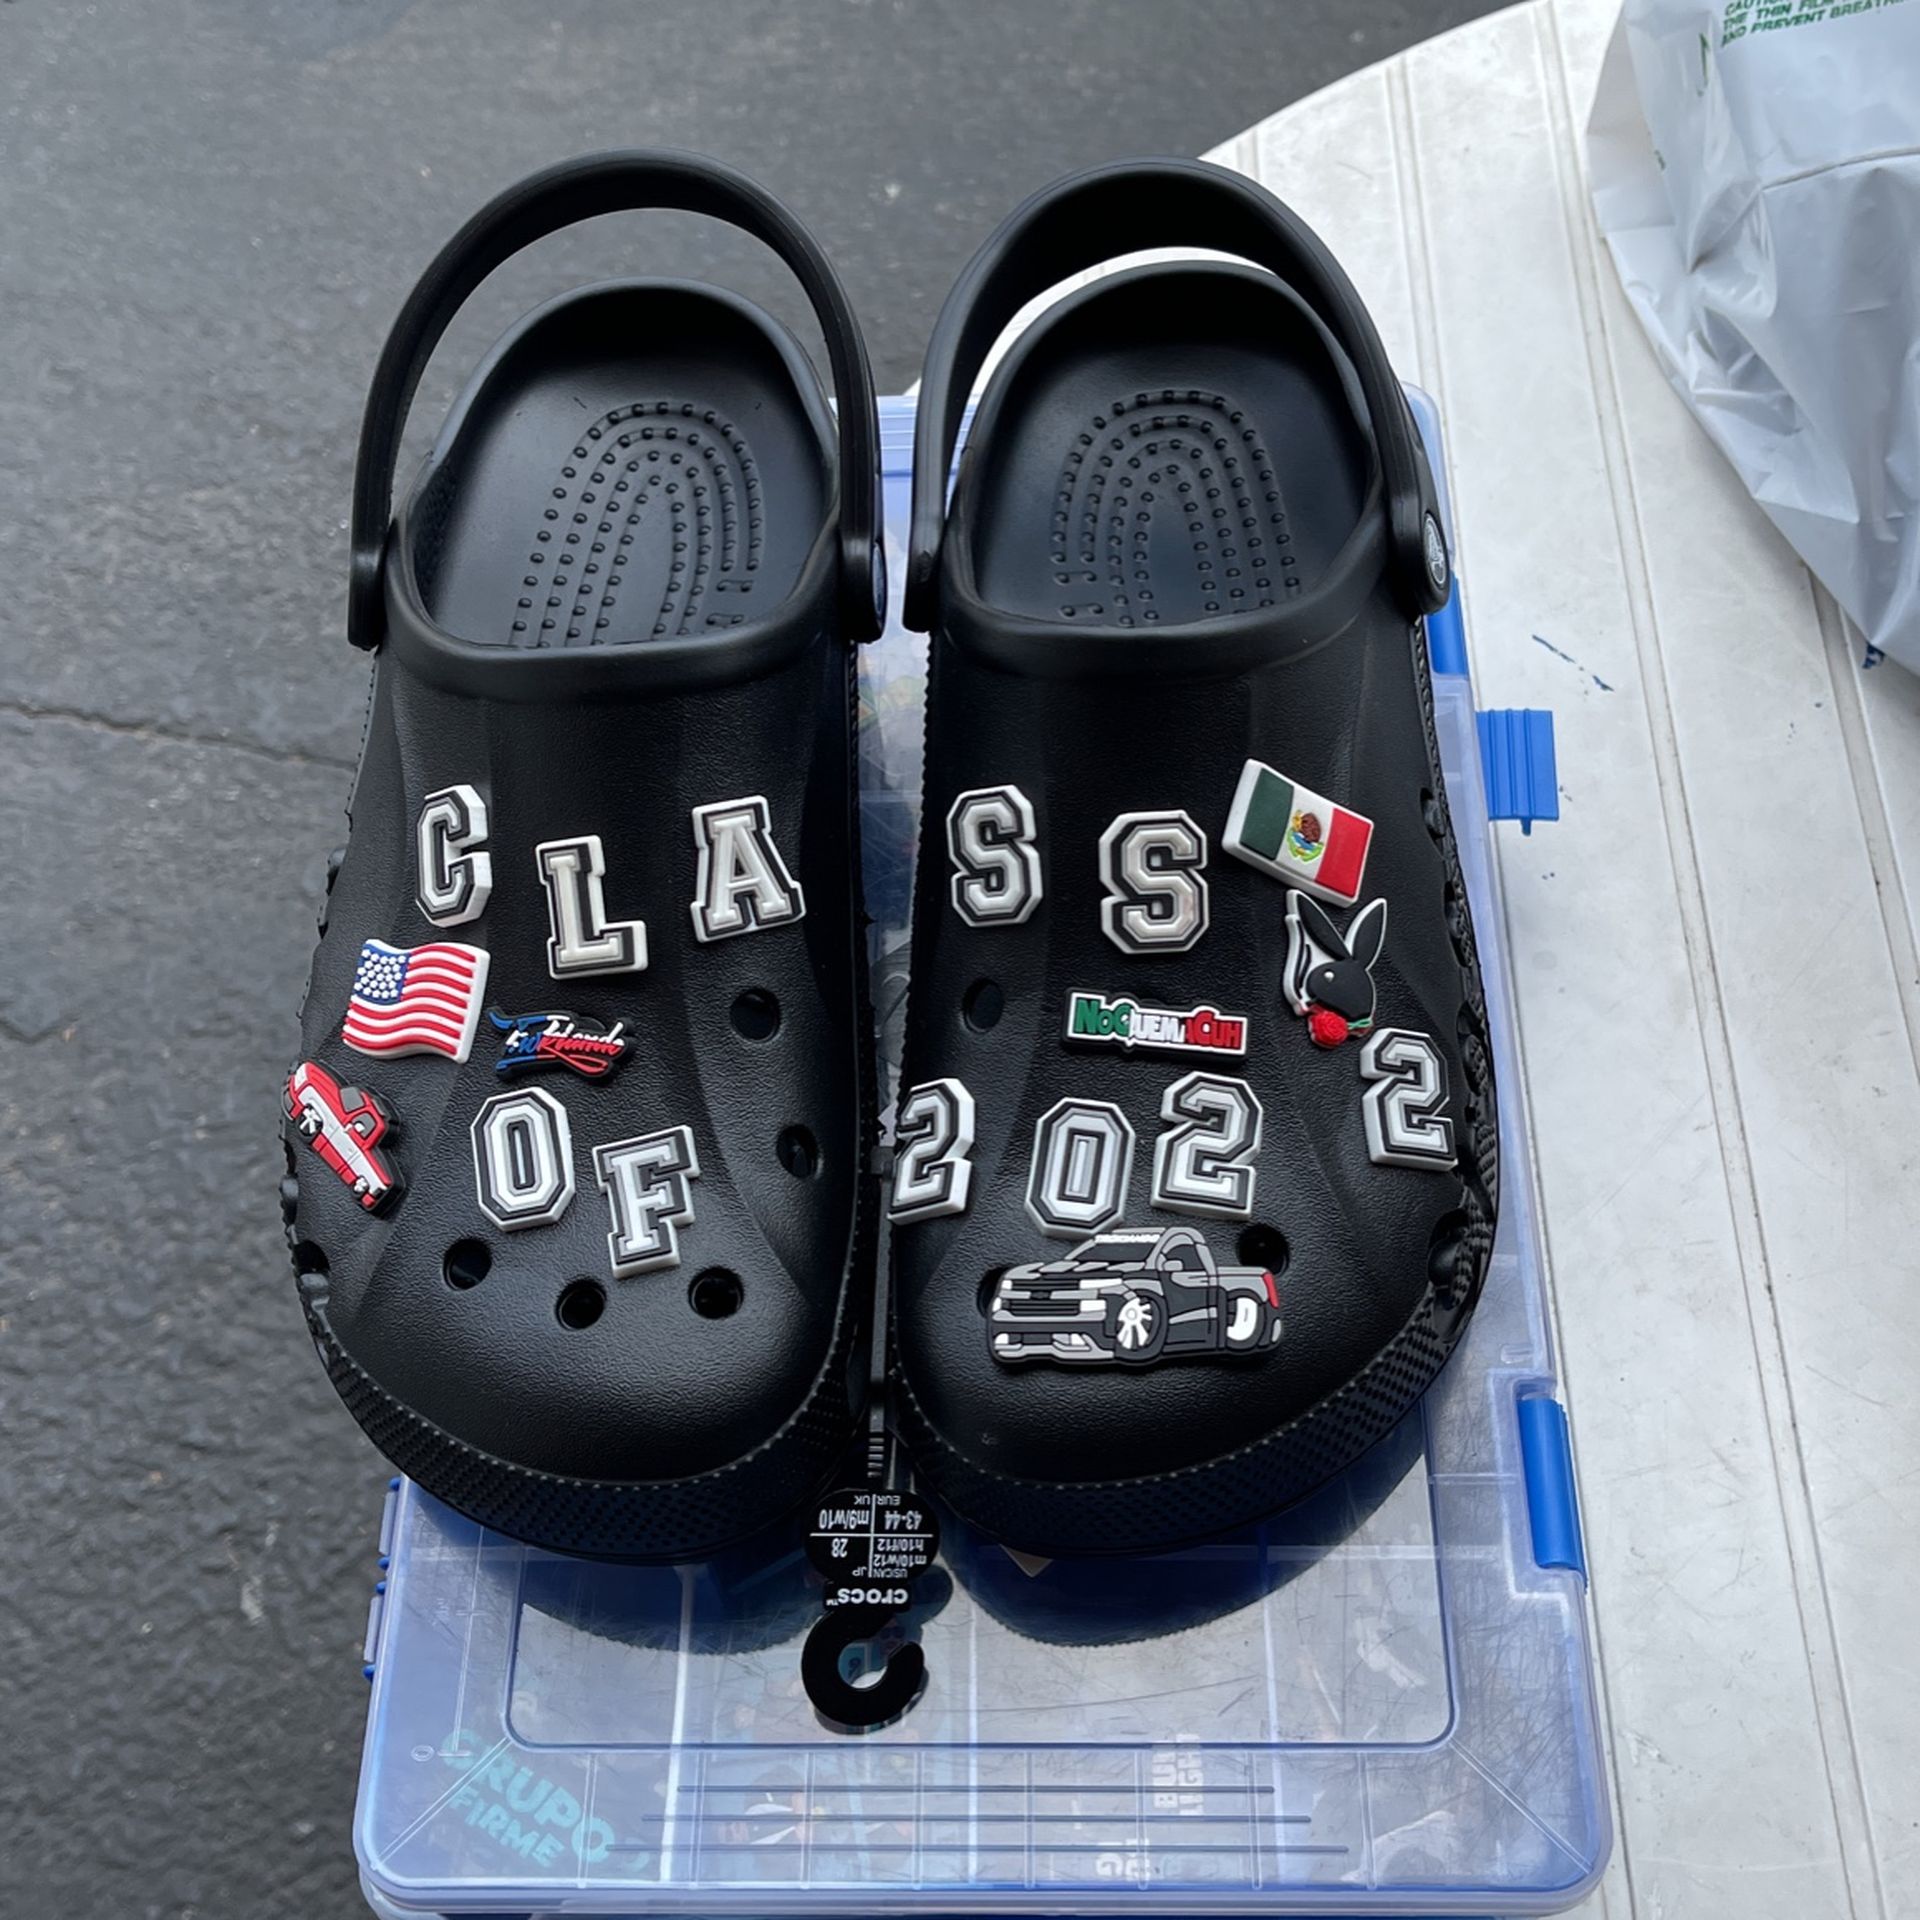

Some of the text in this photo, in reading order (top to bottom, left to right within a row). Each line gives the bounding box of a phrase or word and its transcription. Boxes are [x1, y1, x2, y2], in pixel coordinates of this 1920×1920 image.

[1751, 9, 1826, 34] PREVENT
[470, 1086, 700, 1278] OF
[853, 1495, 871, 1506] UK
[876, 1495, 901, 1506] EUR
[818, 1508, 870, 1530] m9/w10
[884, 1510, 923, 1531] 43-44
[831, 1537, 849, 1558] 28
[851, 1566, 867, 1577] JP
